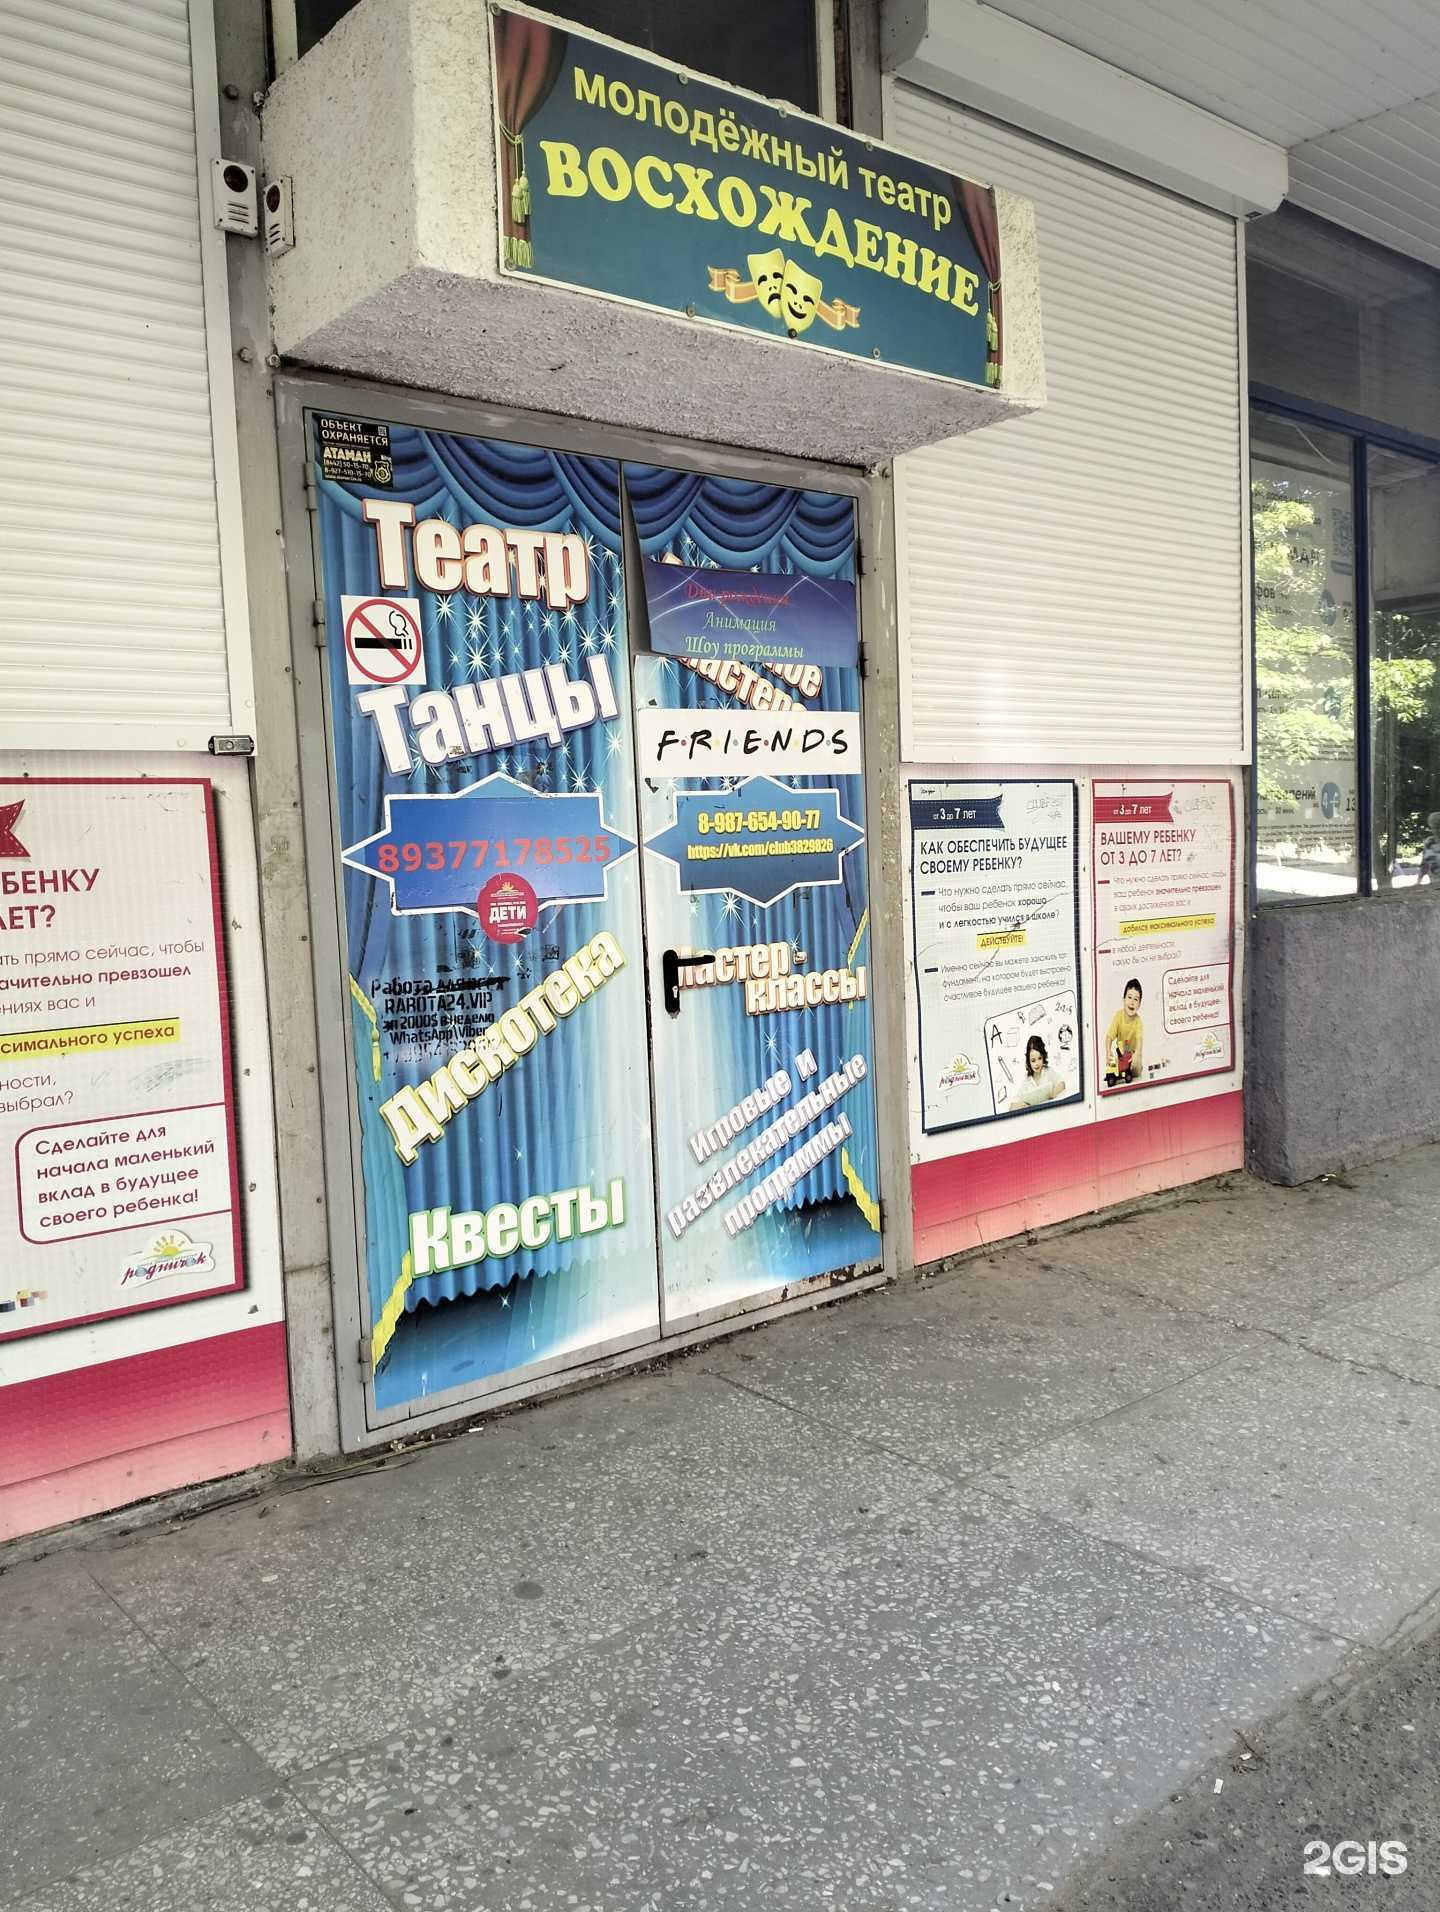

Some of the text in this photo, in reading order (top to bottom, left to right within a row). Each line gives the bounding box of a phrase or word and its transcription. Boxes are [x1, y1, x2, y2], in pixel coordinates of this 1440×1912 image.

[574, 67, 951, 231] молодёжный театр
[539, 140, 981, 318] ВОСХОЖДЕНИЕ
[321, 419, 362, 432] ОБЪЕКТ
[322, 429, 388, 447] ОХРАНЯЕТСЯ
[323, 446, 372, 463] АТАМАН
[362, 498, 590, 611] Театр
[703, 610, 777, 633] Анимация
[685, 636, 804, 661] Шоу программы
[358, 654, 619, 775] Танцы
[940, 808, 947, 820] 3
[954, 807, 961, 820] 7
[962, 809, 977, 820] лет
[1132, 804, 1138, 815] 7
[698, 810, 820, 835] 8-987-654-90-77
[920, 836, 1068, 855] КАК ОБЕСПЕЧИТЬ БУДУЩЕЕ
[1101, 829, 1197, 845] ВАШЕМУ РЕБЕНКУ
[377, 834, 611, 873] 89377178525
[920, 856, 1023, 875] СВОЕМУ РЕБЕНКУ?
[1100, 848, 1182, 867] ОТ 3 ДО 7 ЛЕТ?
[938, 887, 952, 897] Что
[954, 887, 980, 898] нужно
[1017, 897, 1047, 908] хорошо
[489, 905, 527, 924] ДЕТИ
[954, 916, 997, 928] легкостью
[997, 913, 1024, 926] учился
[24, 950, 80, 967] прямо
[85, 943, 155, 961] сейчас,
[159, 938, 205, 956] чтобы
[98, 966, 191, 987] превзошел
[47, 997, 80, 1011] вас
[86, 996, 95, 1008] и
[745, 966, 867, 1016] классы
[0, 1024, 175, 1054] симального успеха
[379, 931, 628, 1166] Дискотека
[689, 1048, 817, 1165] Игровые и
[35, 1125, 167, 1156] Сделайте для
[666, 1054, 867, 1238] развлекательные
[37, 1140, 216, 1180] начала маленький
[38, 1167, 200, 1205] вклад в будущее
[723, 1112, 852, 1239] программы
[39, 1188, 200, 1229] своего ребенка!
[409, 1176, 626, 1278] Квесты
